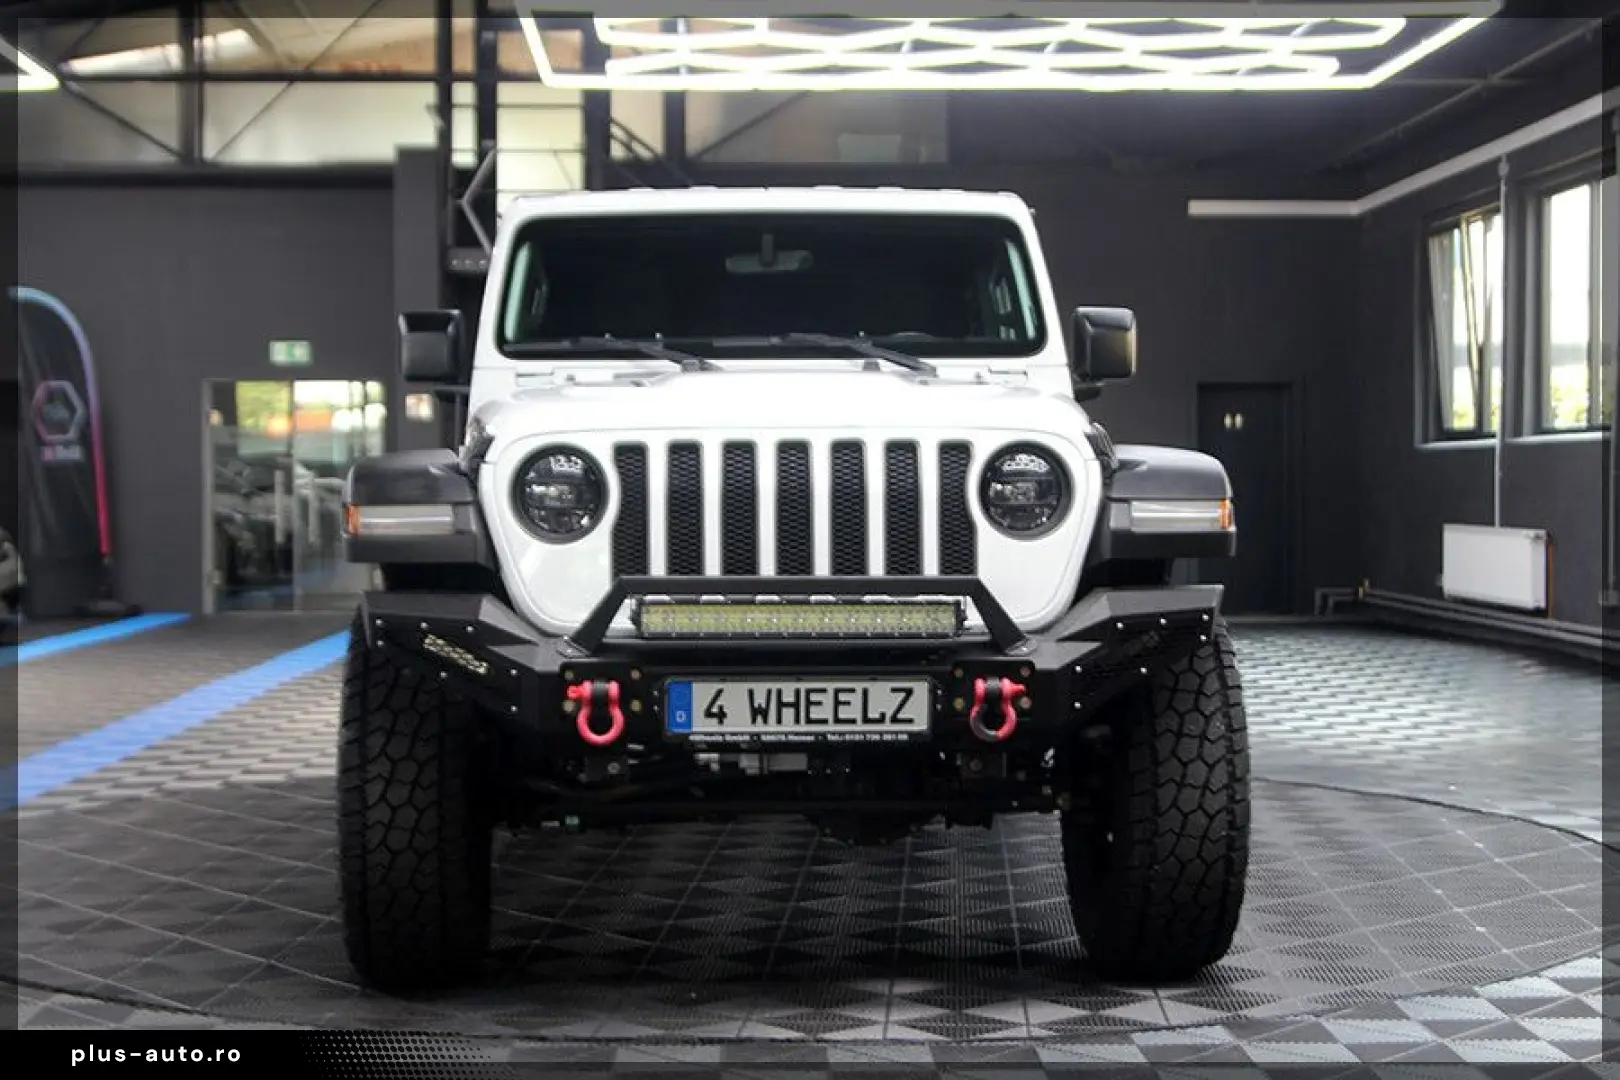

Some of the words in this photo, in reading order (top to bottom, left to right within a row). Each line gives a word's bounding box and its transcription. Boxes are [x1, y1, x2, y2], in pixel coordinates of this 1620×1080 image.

[675, 711, 687, 723] D
[703, 687, 728, 726] 4
[747, 687, 915, 726] WHEELZ
